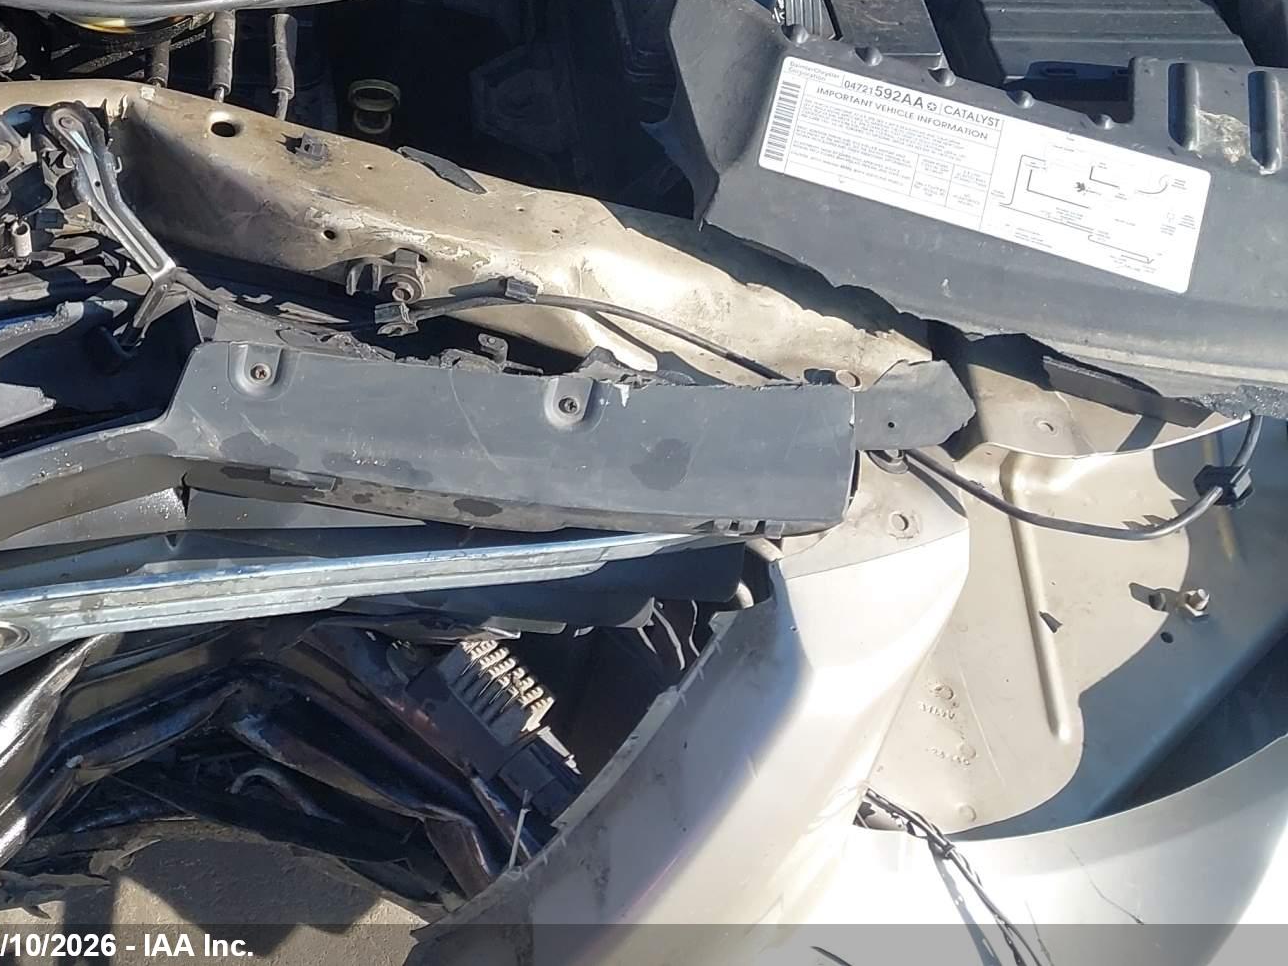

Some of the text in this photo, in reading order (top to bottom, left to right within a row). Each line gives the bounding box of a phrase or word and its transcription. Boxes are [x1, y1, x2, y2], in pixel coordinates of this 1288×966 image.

[842, 76, 925, 109] 04721592AA
[815, 86, 873, 108] IMPORTANT
[875, 102, 914, 119] VEHICLE
[915, 113, 988, 140] INFORMATION
[942, 104, 1000, 128] CATALYST
